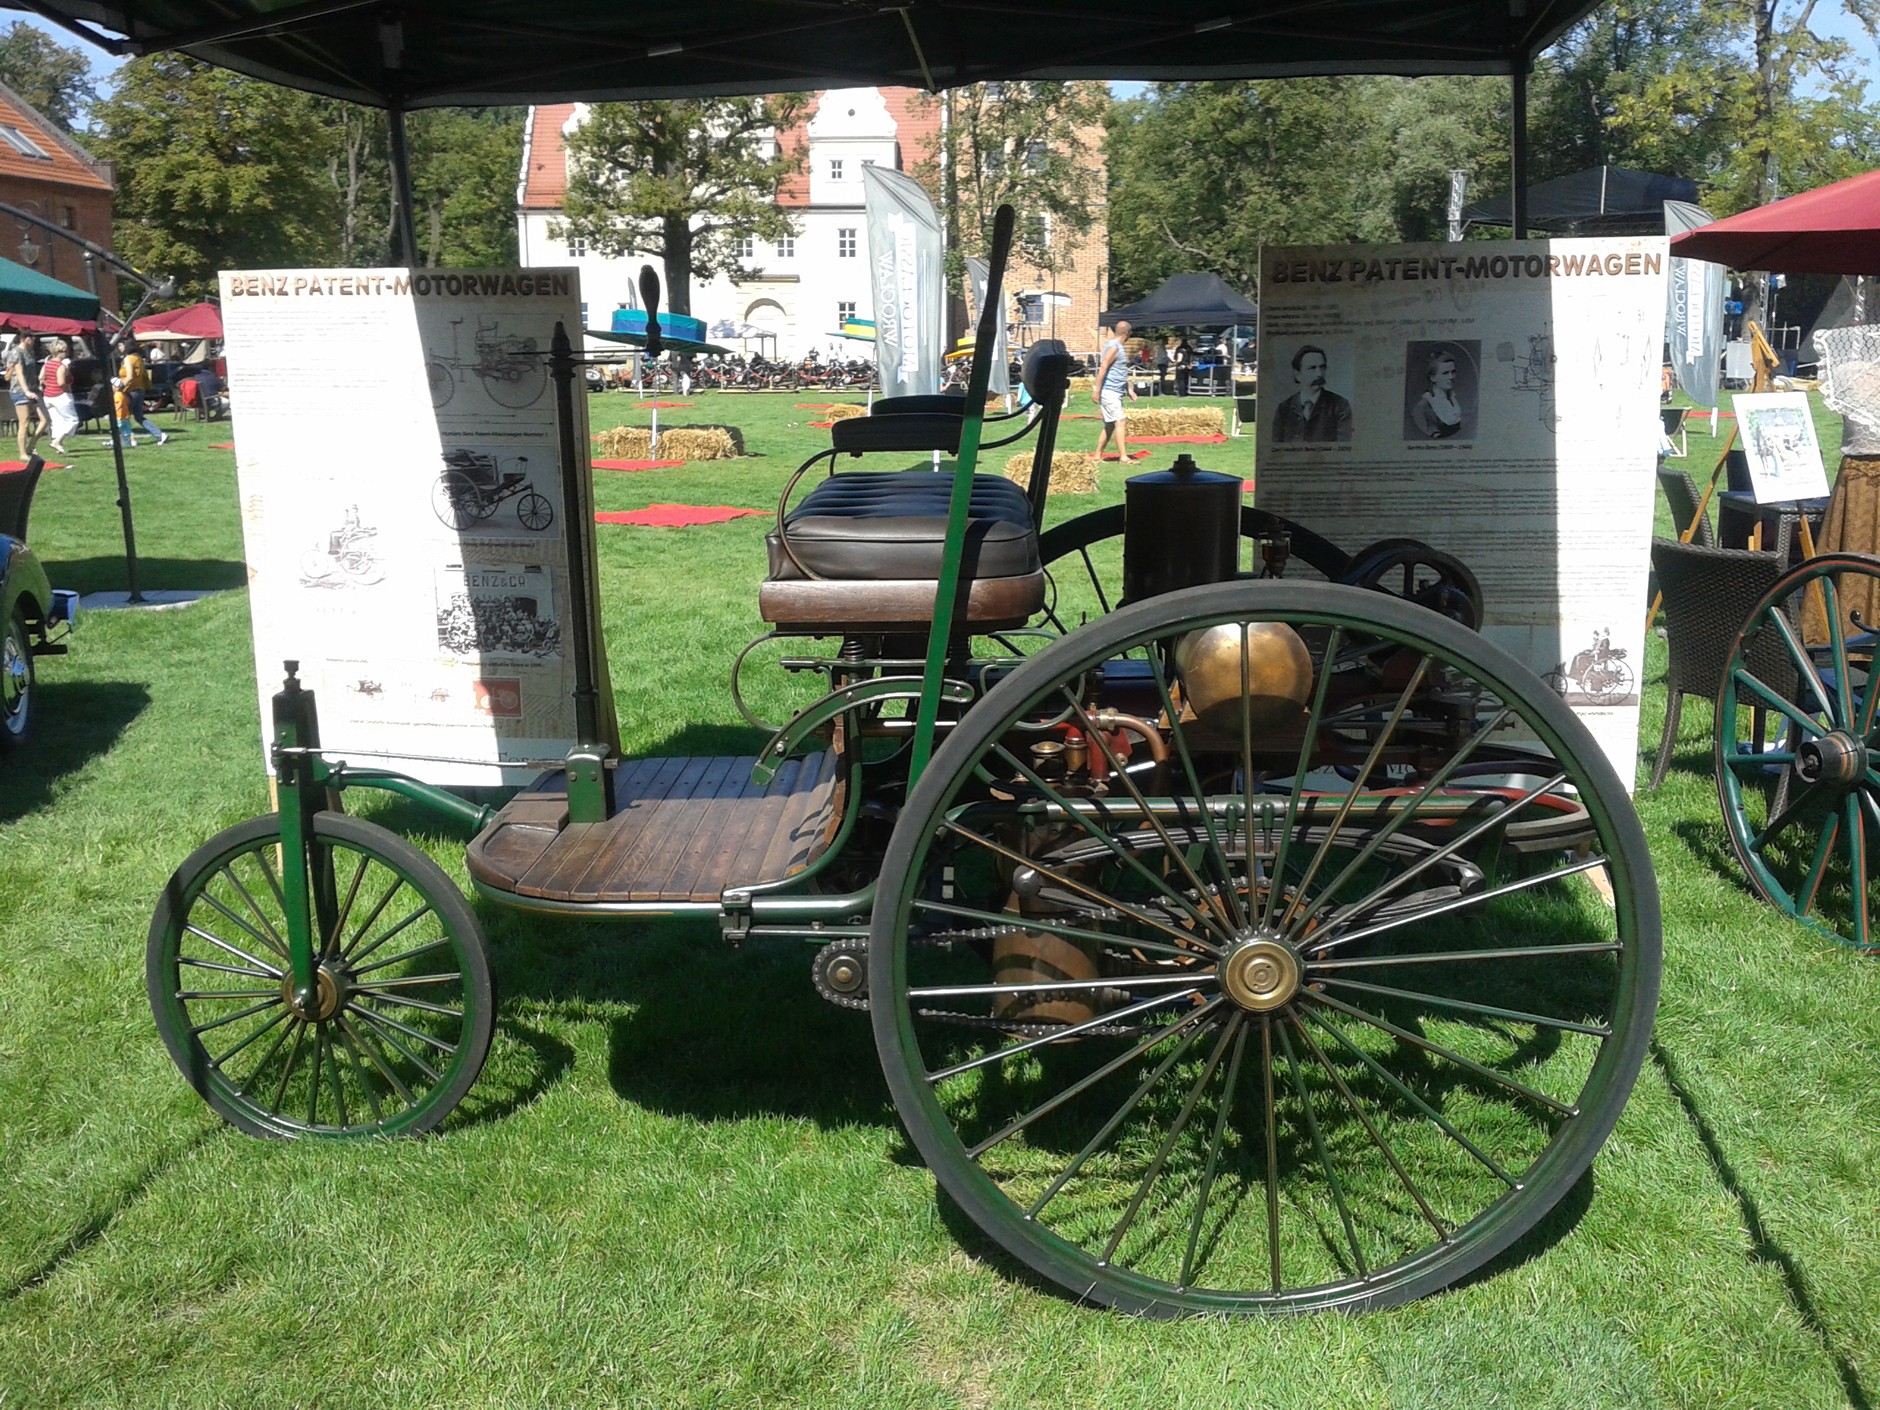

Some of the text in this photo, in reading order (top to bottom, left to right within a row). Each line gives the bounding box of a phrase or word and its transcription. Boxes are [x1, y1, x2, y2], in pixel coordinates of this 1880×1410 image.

[1272, 252, 1662, 284] BENZ PATENT-MOTORWAGEN
[230, 273, 569, 297] BENZ PATENT-MOTORWAGEN
